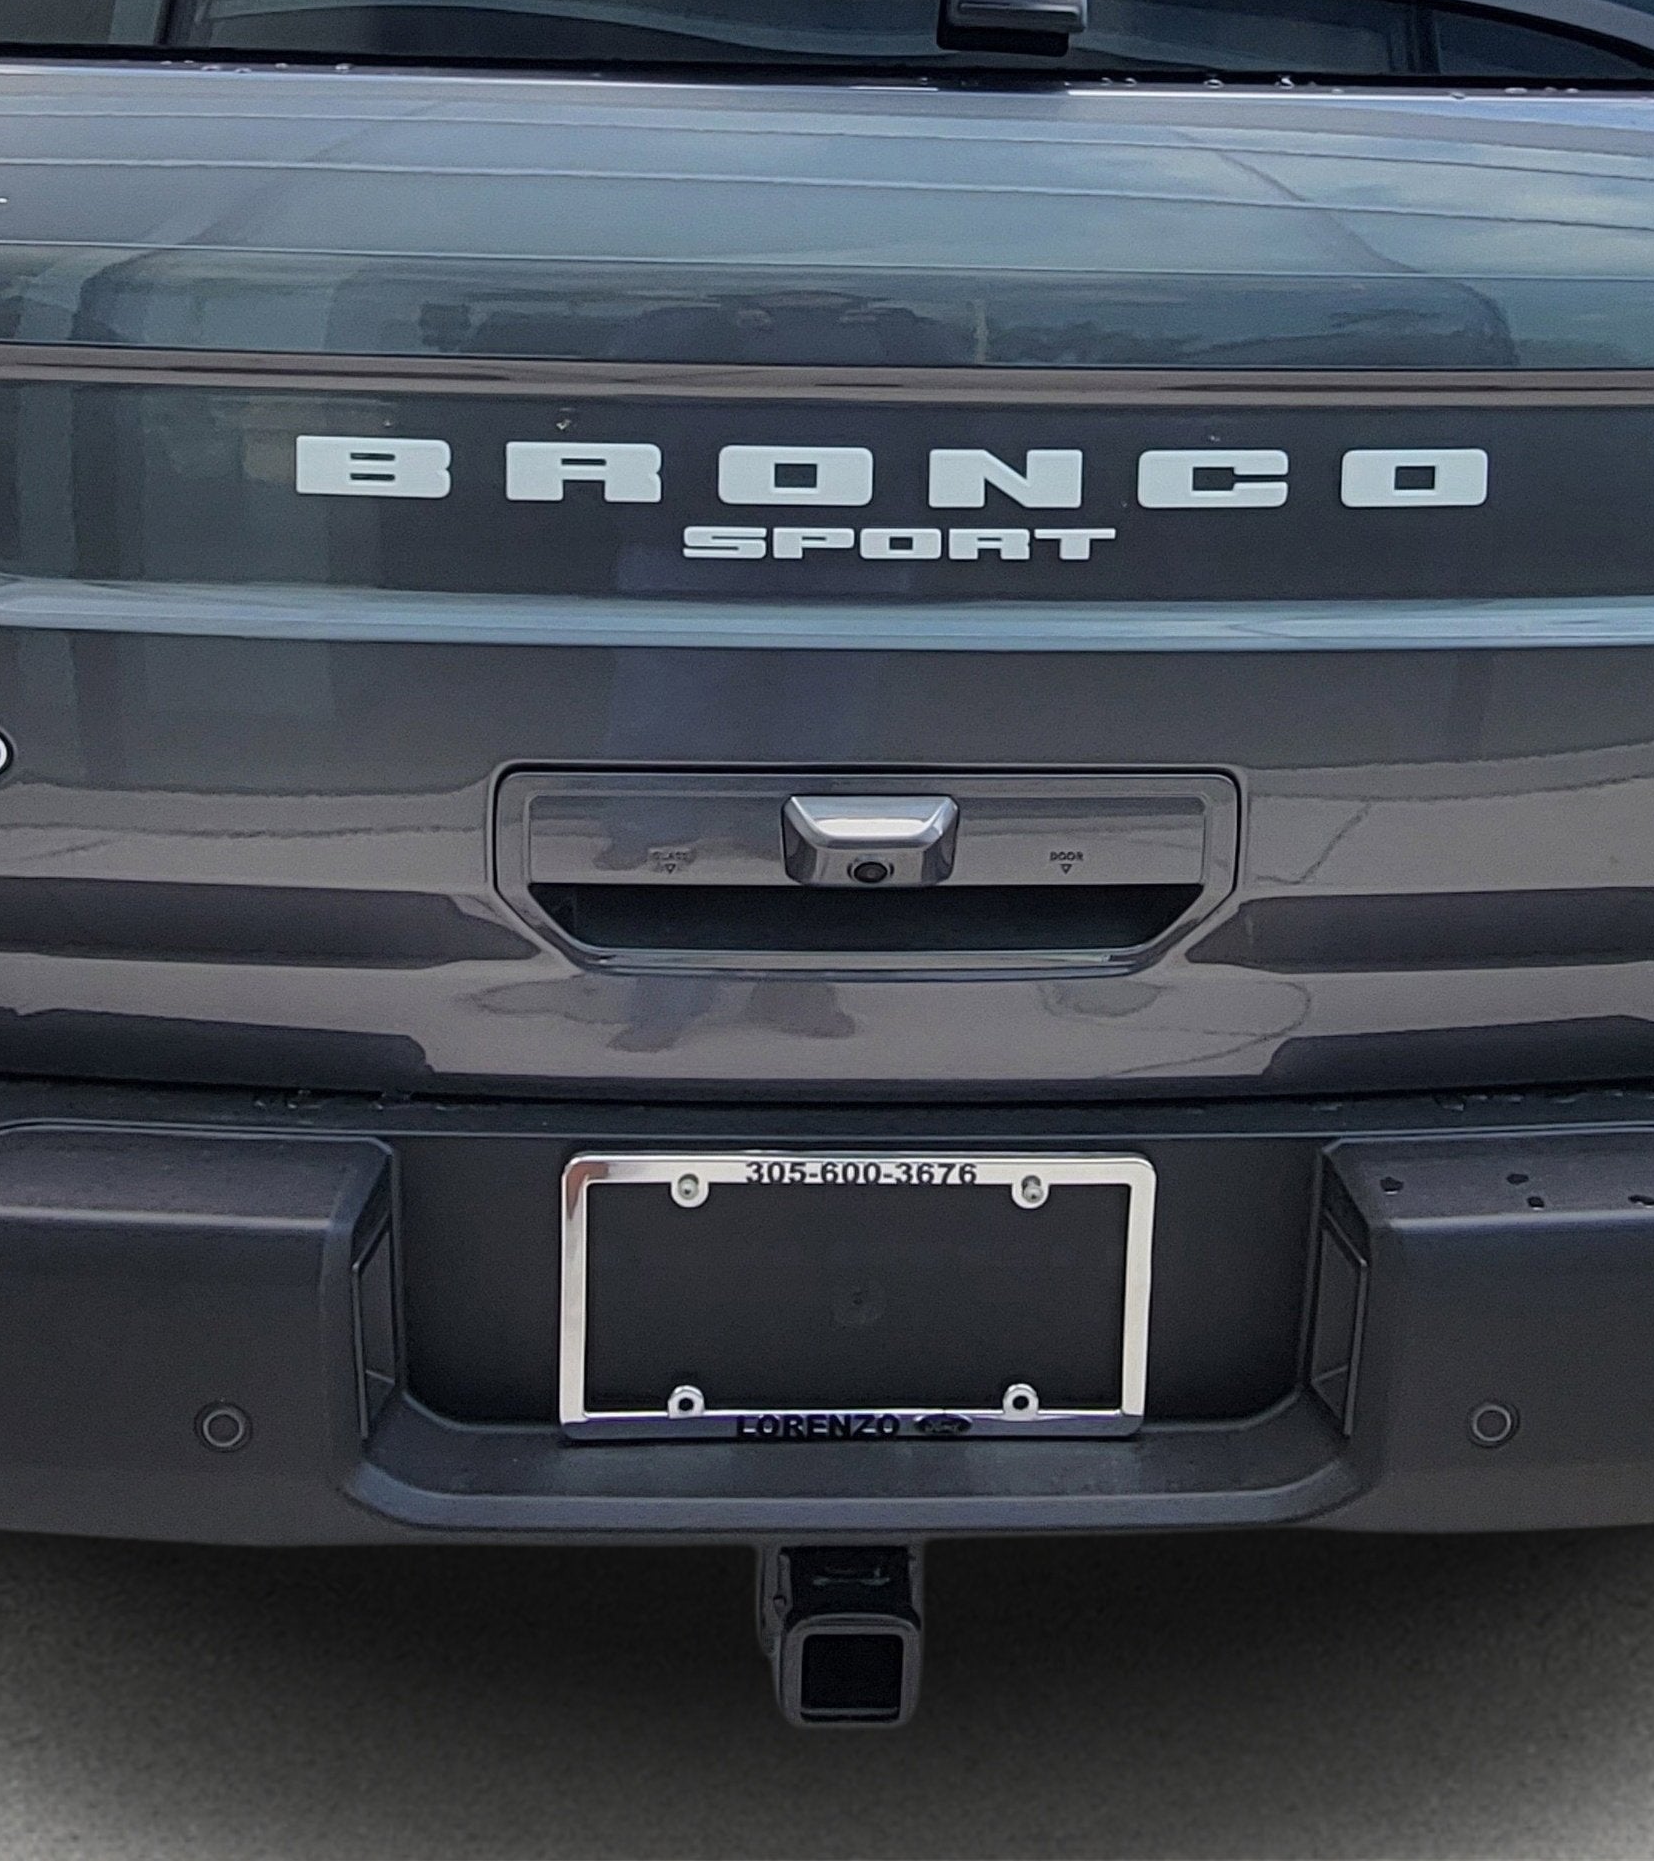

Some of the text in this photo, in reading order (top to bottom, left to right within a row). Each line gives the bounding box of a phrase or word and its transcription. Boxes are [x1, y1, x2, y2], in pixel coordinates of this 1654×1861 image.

[296, 434, 1489, 509] BRONCO
[682, 527, 1115, 560] SPORT
[1050, 851, 1084, 861] DOOR
[746, 1161, 978, 1185] 305-600-3676
[736, 1414, 900, 1438] LORENZO
